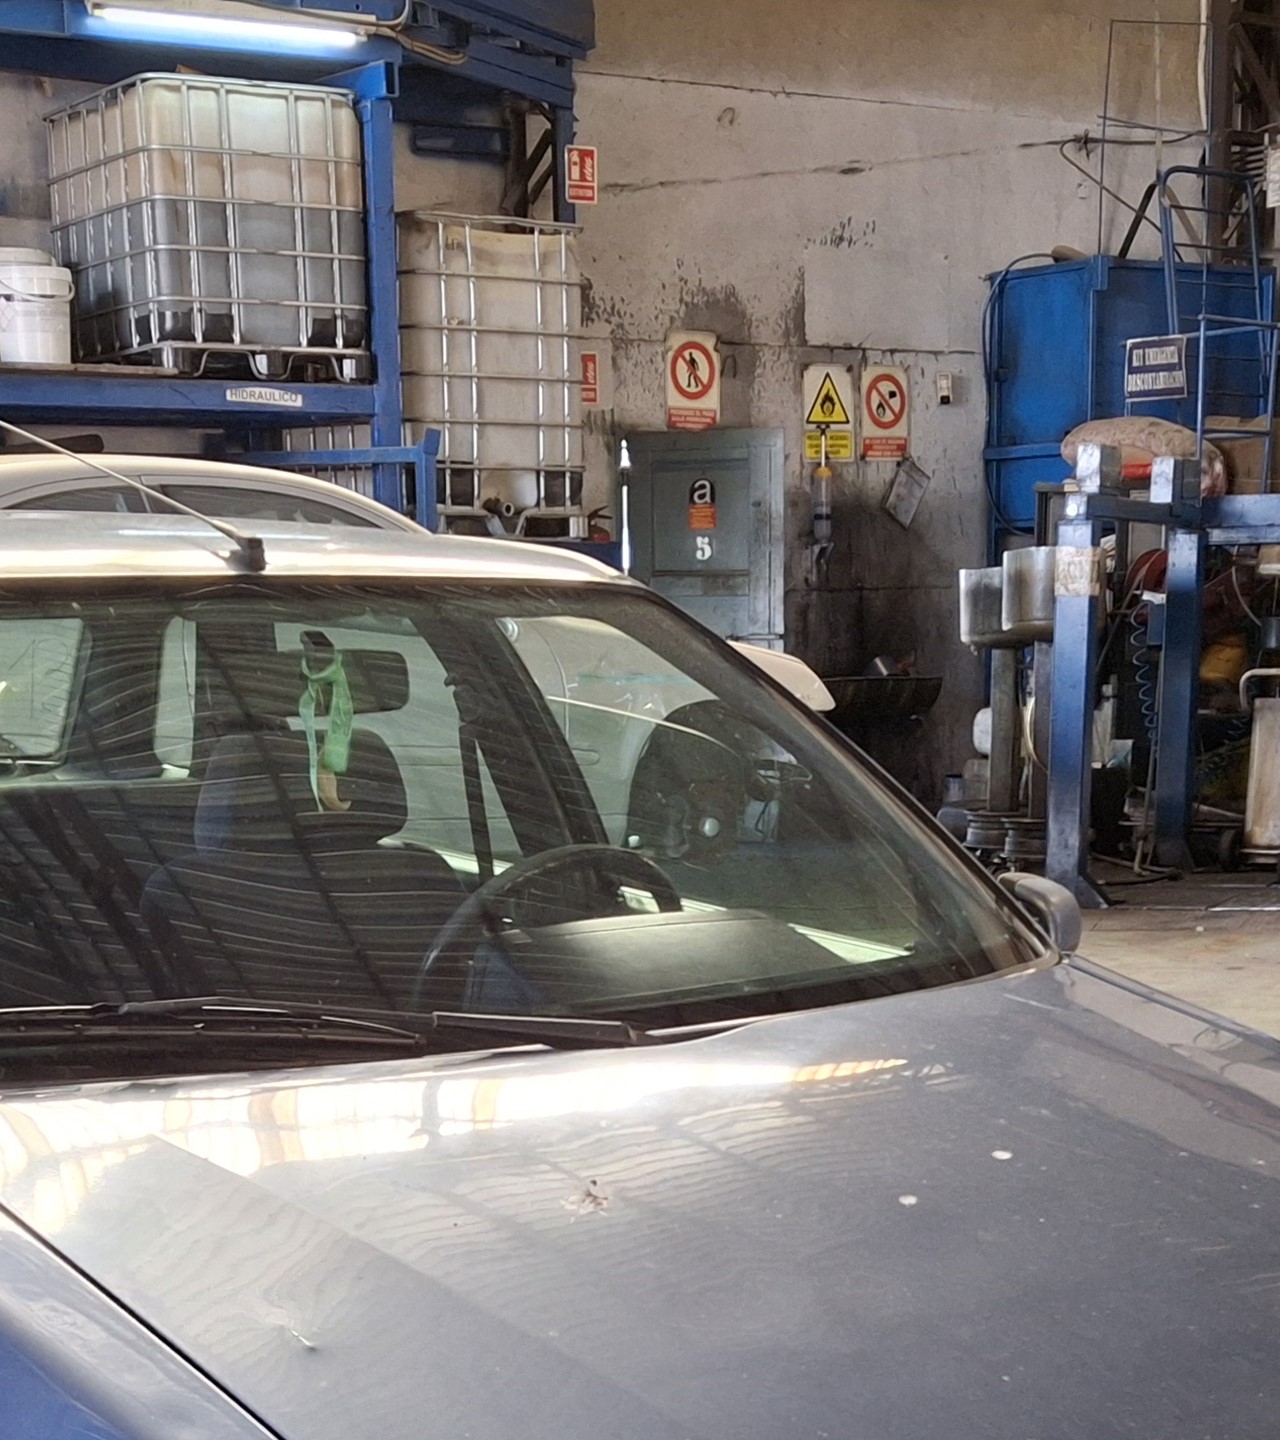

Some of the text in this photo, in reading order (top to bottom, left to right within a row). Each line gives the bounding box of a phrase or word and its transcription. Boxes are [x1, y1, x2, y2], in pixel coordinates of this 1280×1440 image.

[230, 389, 298, 402] HIDRAULICO
[693, 480, 711, 504] a
[696, 536, 712, 561] 5
